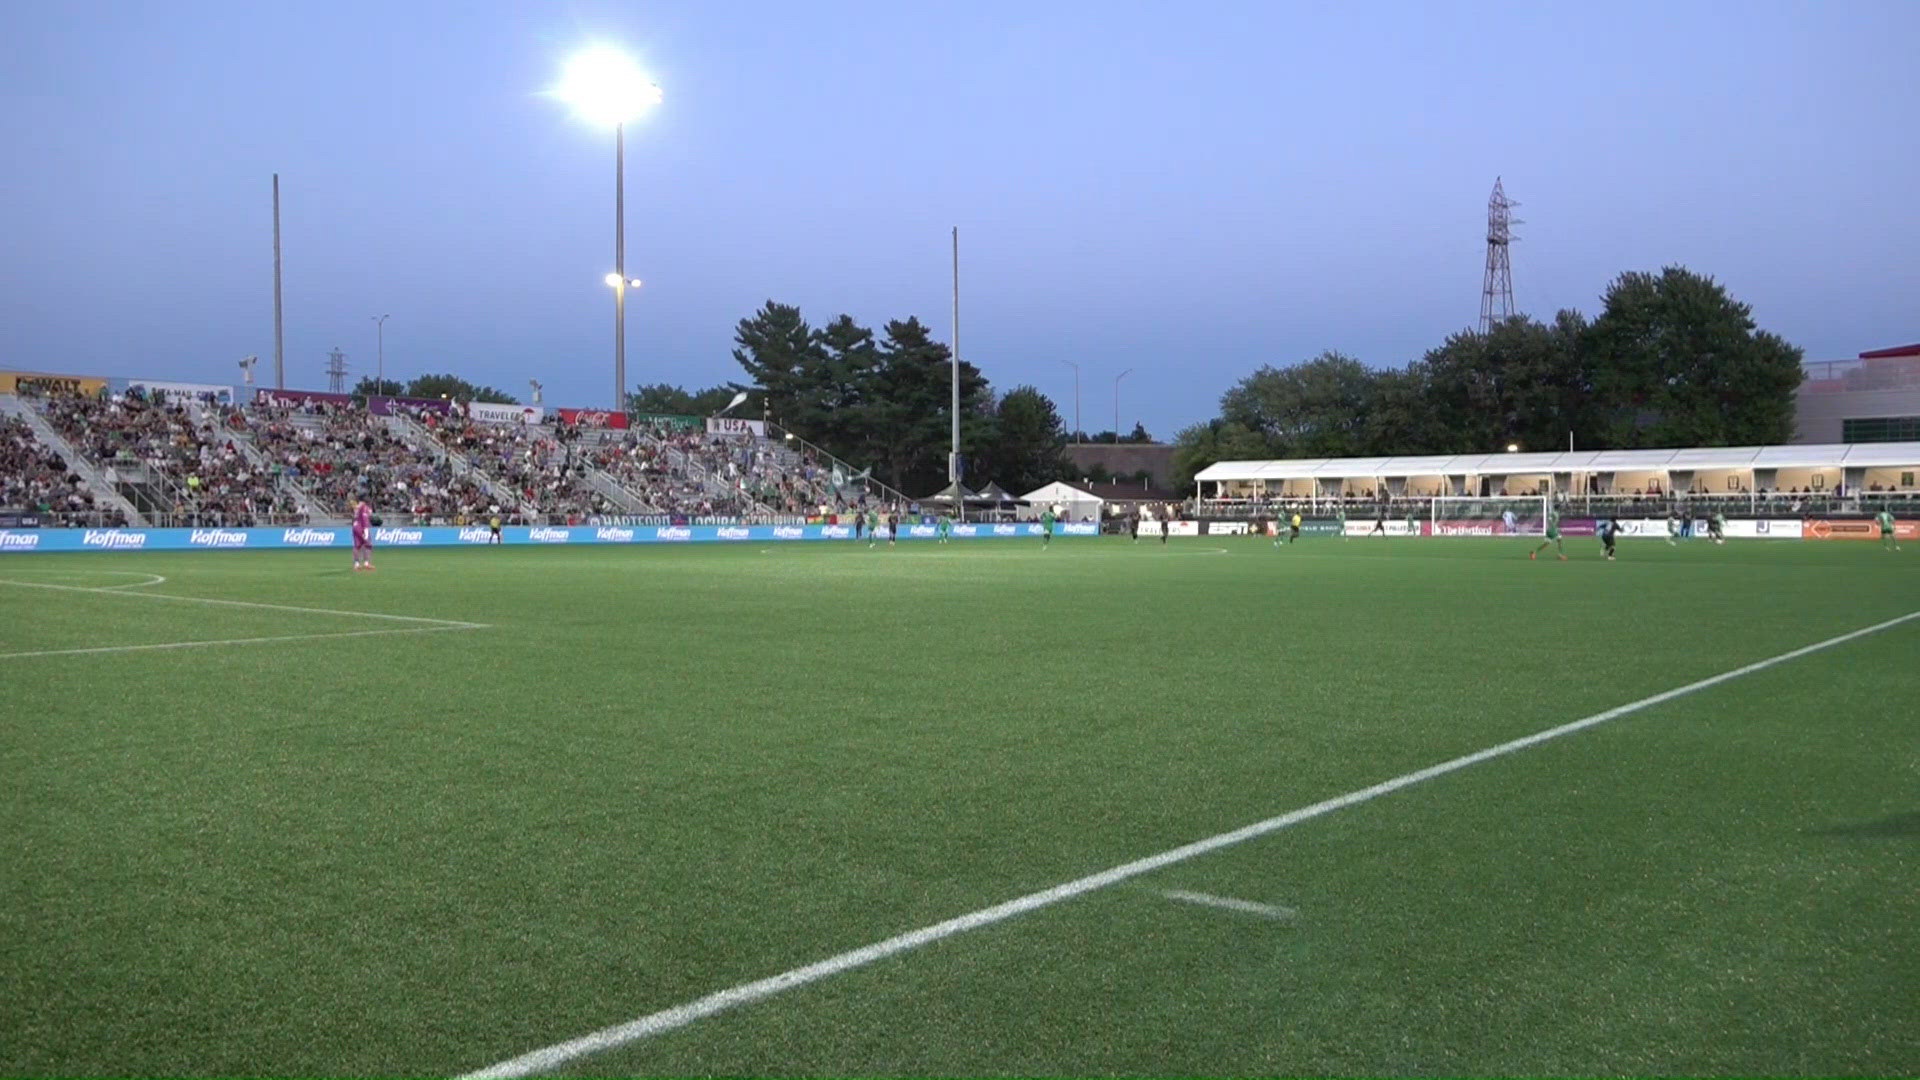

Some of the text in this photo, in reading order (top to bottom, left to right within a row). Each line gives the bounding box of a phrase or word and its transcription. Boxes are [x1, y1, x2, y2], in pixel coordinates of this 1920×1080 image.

[724, 419, 748, 431] USA
[602, 515, 670, 526] HARTFORD
[375, 528, 423, 543] Hoffman
[459, 528, 502, 543] Hoffm
[529, 528, 570, 541] Hoffman
[597, 527, 634, 541] Hoffman
[656, 527, 691, 540] Hoffman
[717, 527, 750, 540] Hoffman
[1442, 524, 1492, 535] The Hartford
[0, 530, 39, 546] fman
[83, 530, 146, 547] Hoffman
[190, 529, 247, 546] Hoffman
[283, 529, 335, 545] Hoffman
